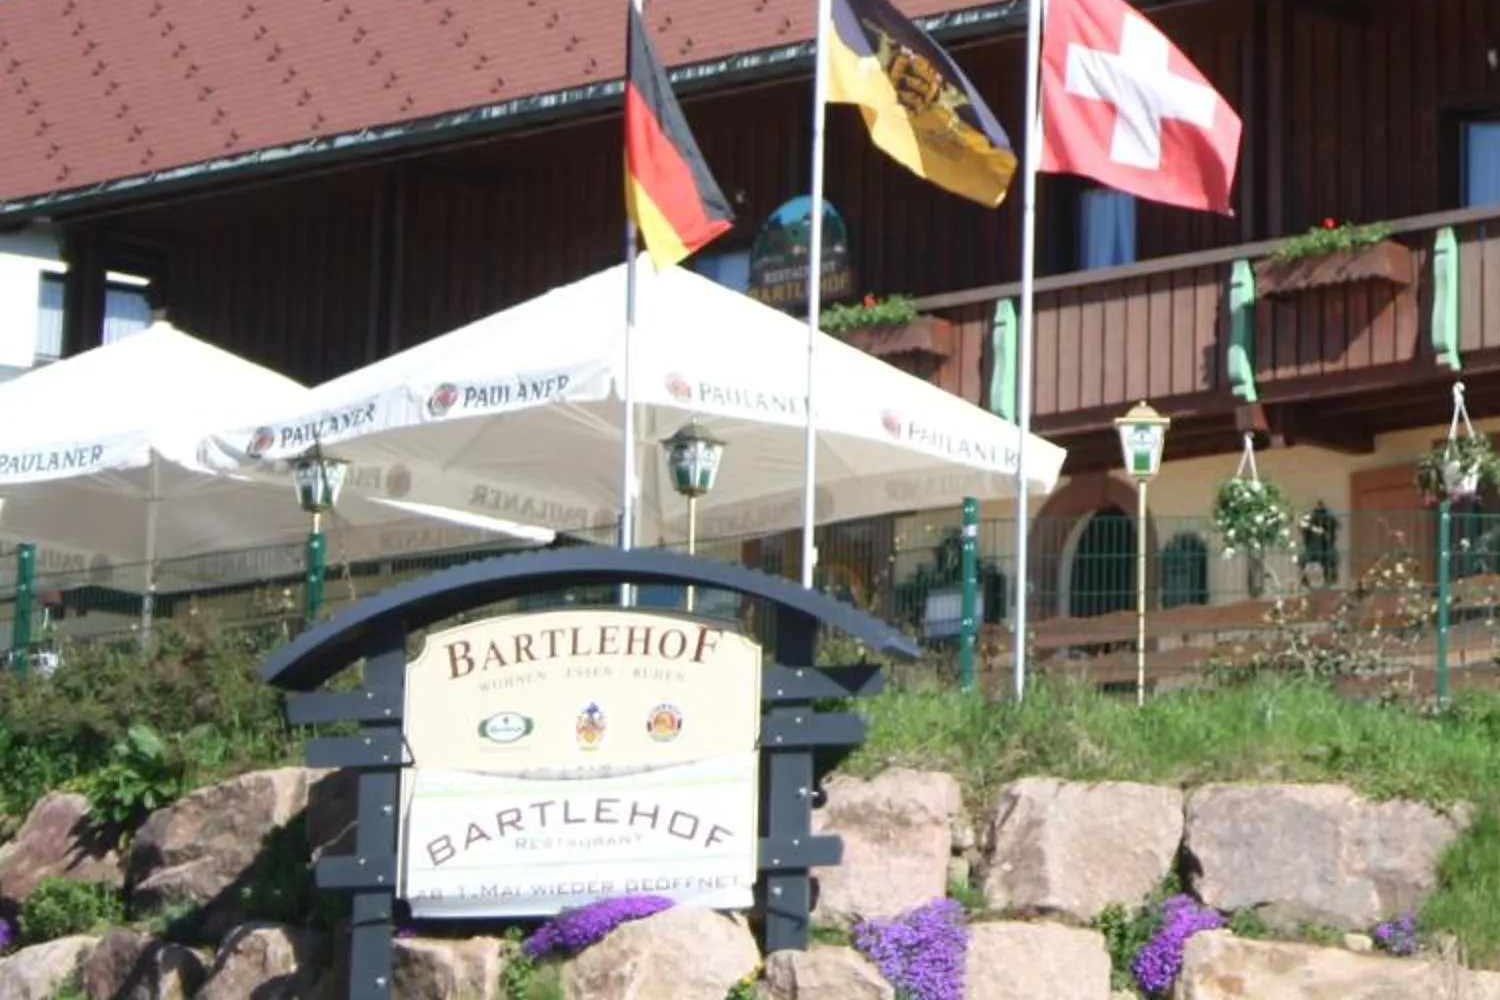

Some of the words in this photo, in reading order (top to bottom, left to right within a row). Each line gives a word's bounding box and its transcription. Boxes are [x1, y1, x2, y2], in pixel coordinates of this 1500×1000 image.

[443, 624, 724, 682] BARTLEHOF
[426, 797, 735, 867] BARTLEHOF
[514, 832, 644, 851] RESTAURANT
[530, 878, 615, 897] WIEDER
